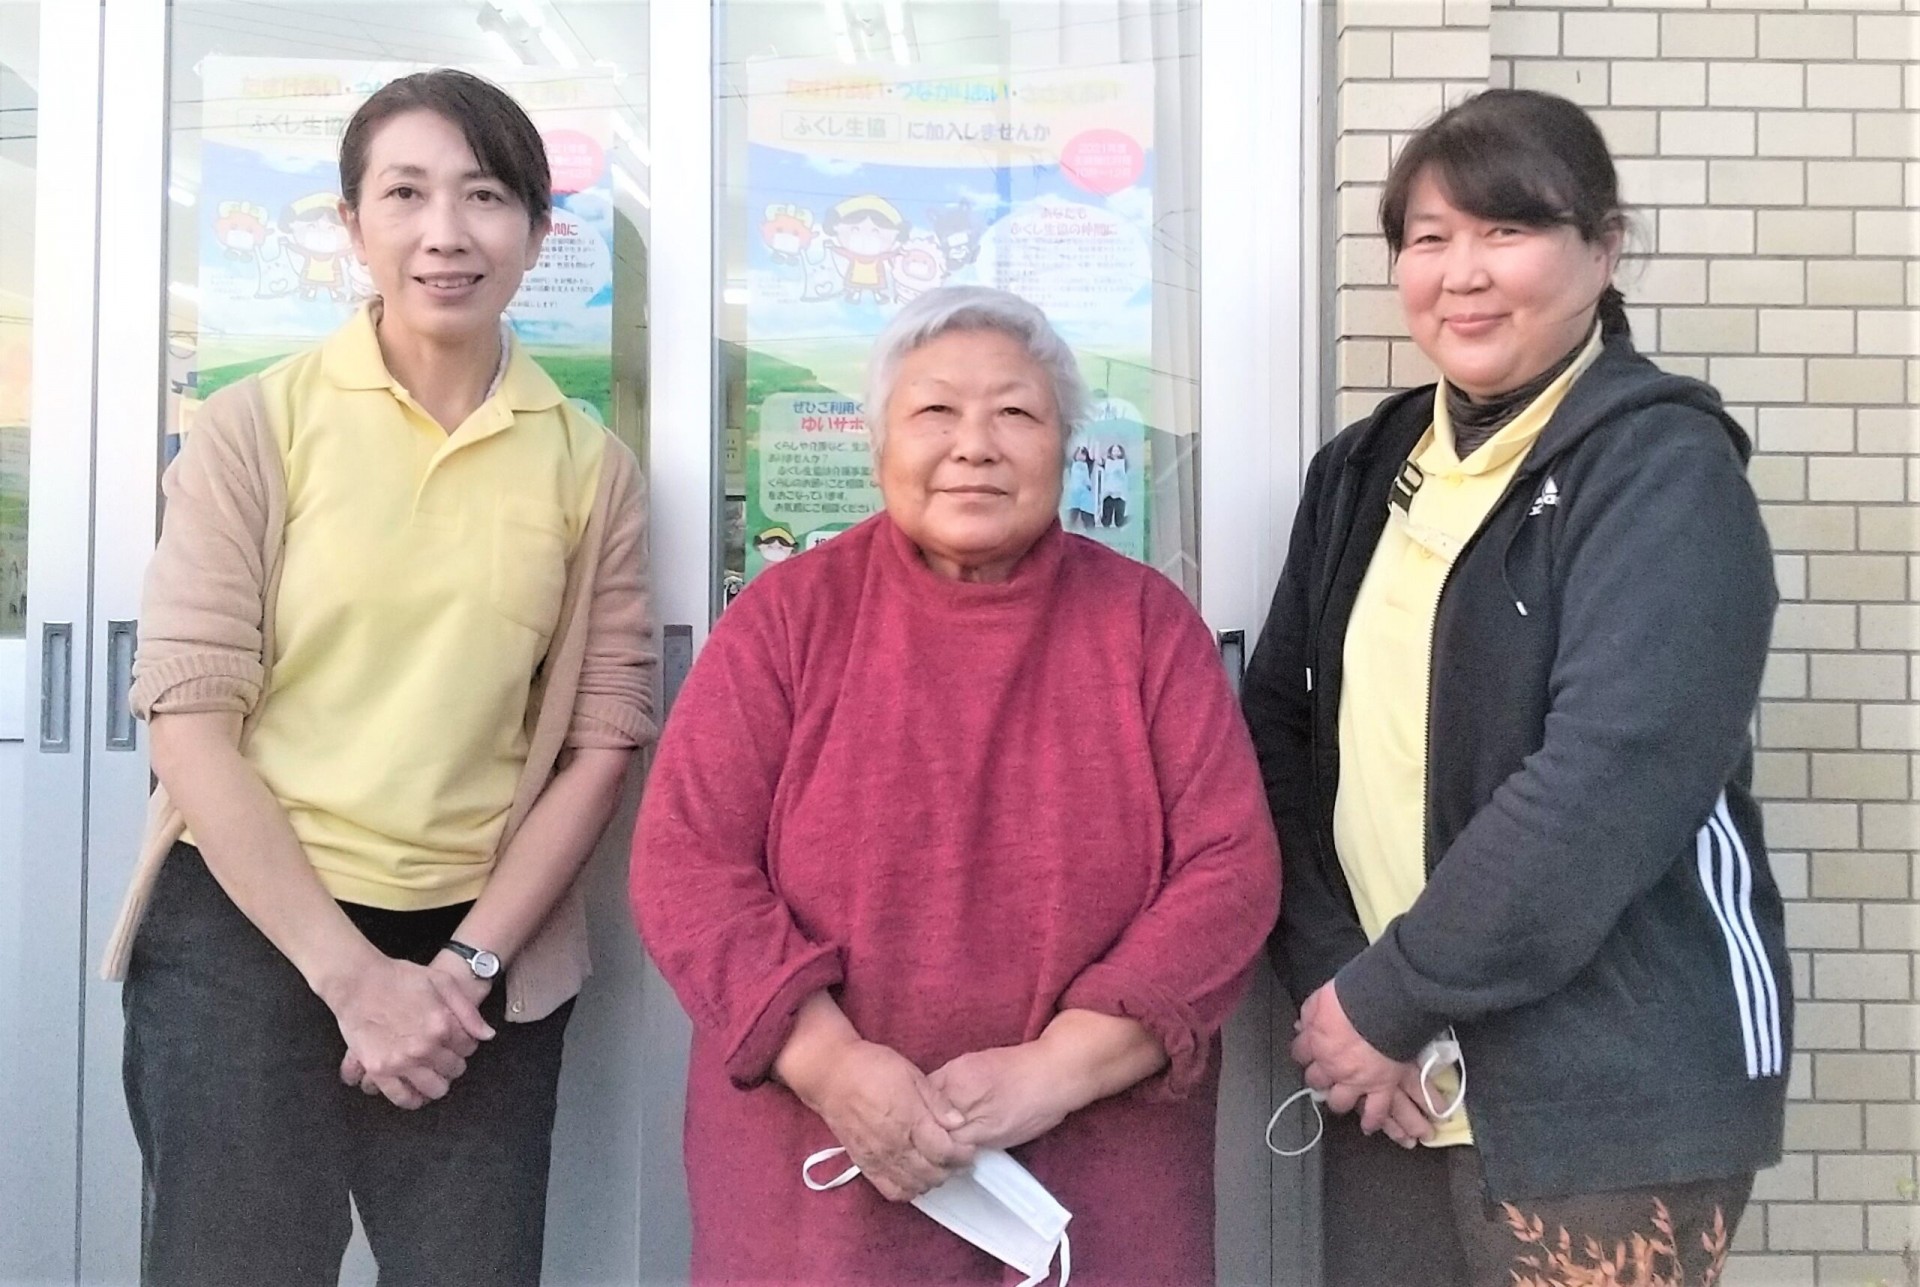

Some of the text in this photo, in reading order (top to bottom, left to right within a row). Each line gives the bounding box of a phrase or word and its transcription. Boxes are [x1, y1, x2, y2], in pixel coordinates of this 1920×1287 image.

[793, 116, 1050, 142] ふくし生協 に加入しませんか
[1010, 222, 1118, 236] ふくし生協の仲間に
[793, 401, 864, 414] ぜひご利用く
